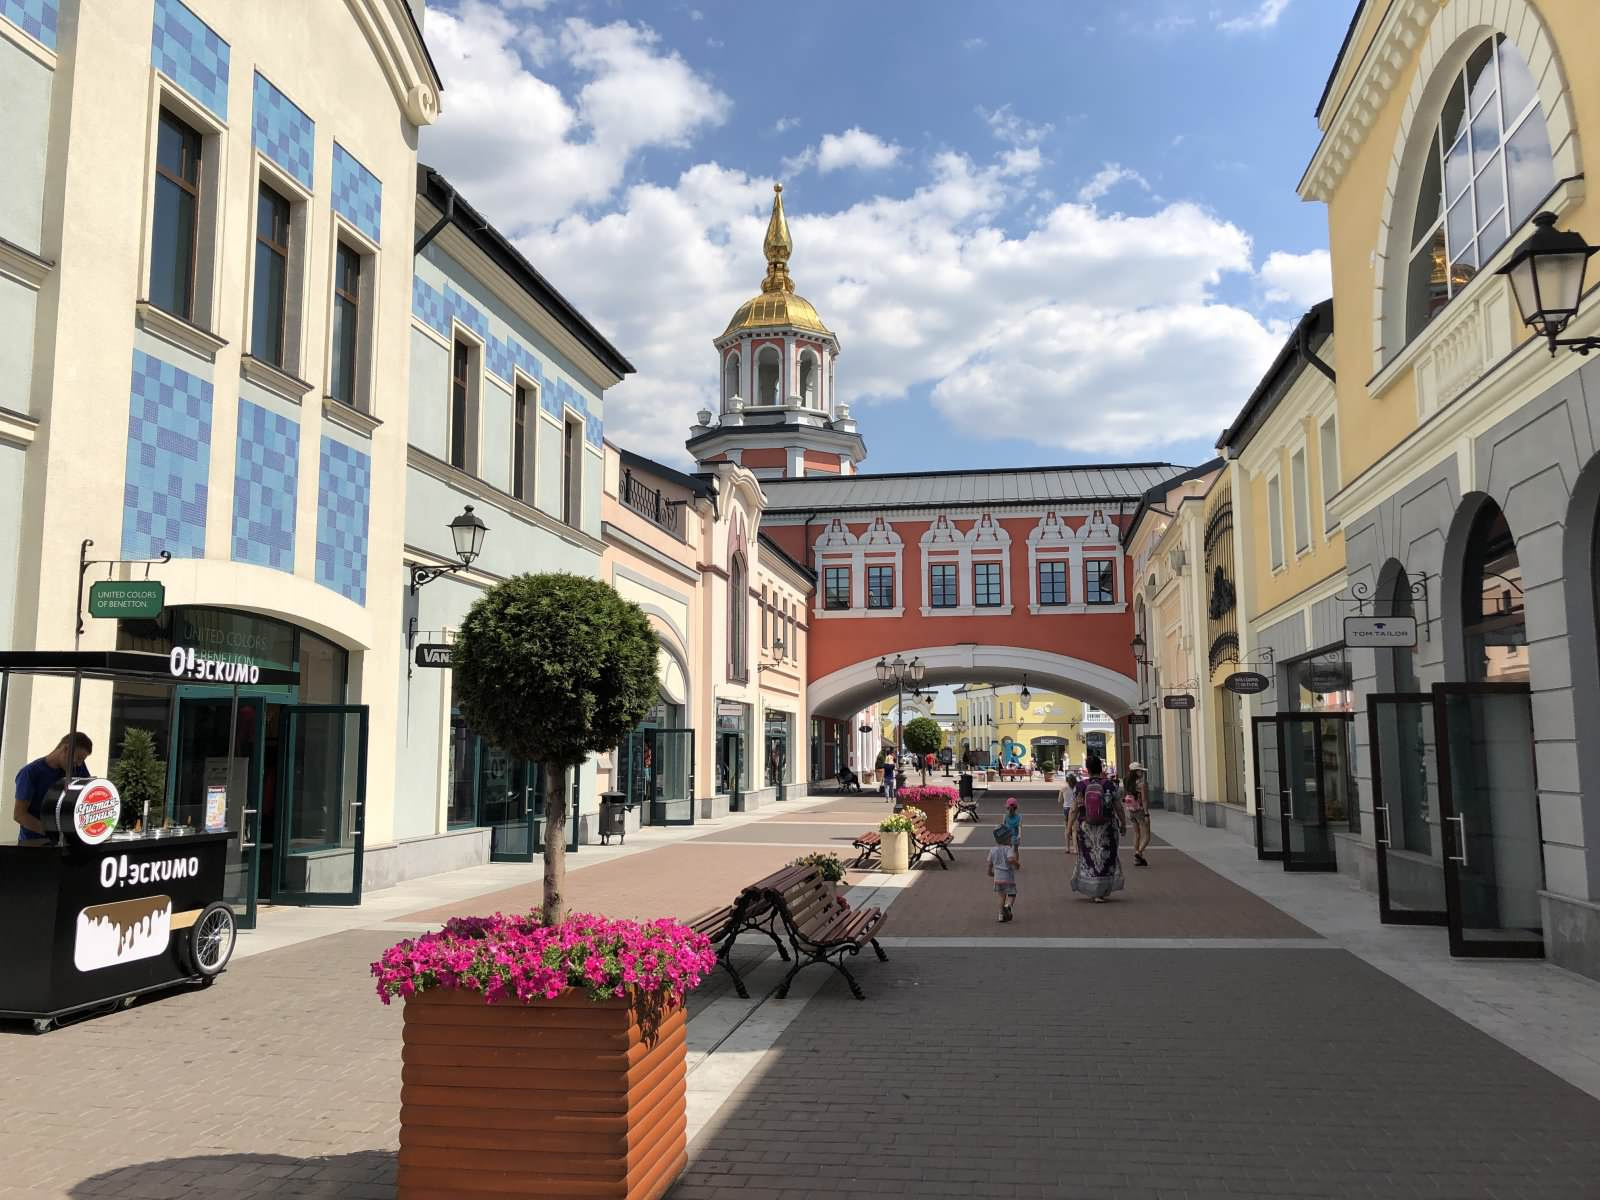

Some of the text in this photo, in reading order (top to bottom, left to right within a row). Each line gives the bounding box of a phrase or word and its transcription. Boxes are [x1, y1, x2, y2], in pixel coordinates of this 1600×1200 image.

[97, 591, 157, 599] UNITED COLORS
[97, 600, 147, 608] OF BENETTON
[184, 622, 267, 650] UNITED COLORS
